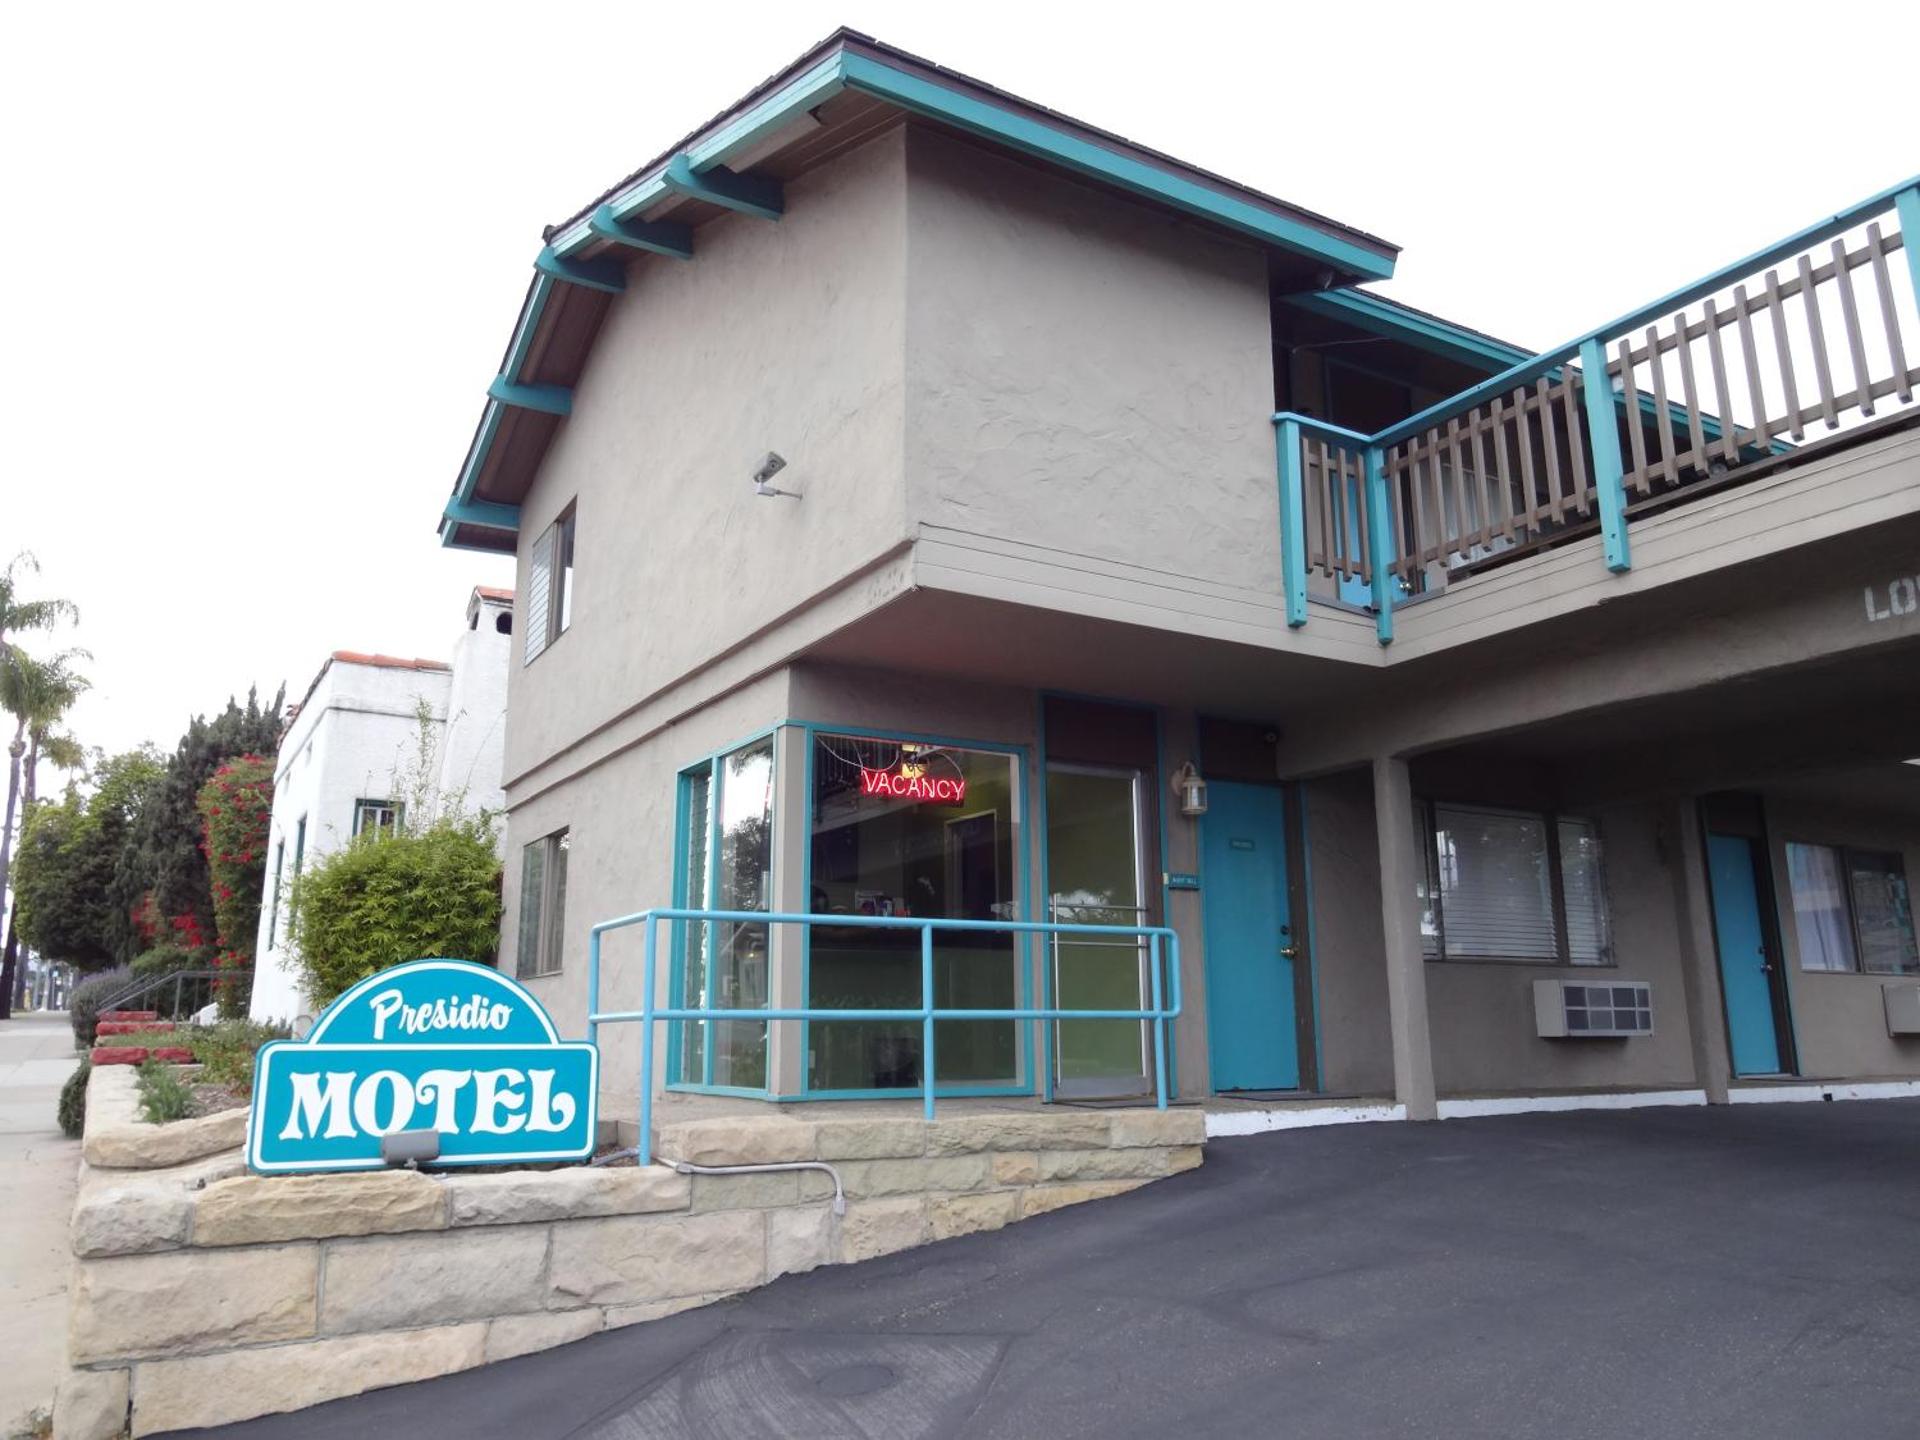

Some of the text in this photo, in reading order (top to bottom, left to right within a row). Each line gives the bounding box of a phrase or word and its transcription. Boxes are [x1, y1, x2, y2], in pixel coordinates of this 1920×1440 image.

[1864, 574, 1920, 621] LO
[861, 769, 965, 802] VACANCY
[369, 988, 513, 1040] Presidio
[279, 1067, 576, 1140] MOTEL
